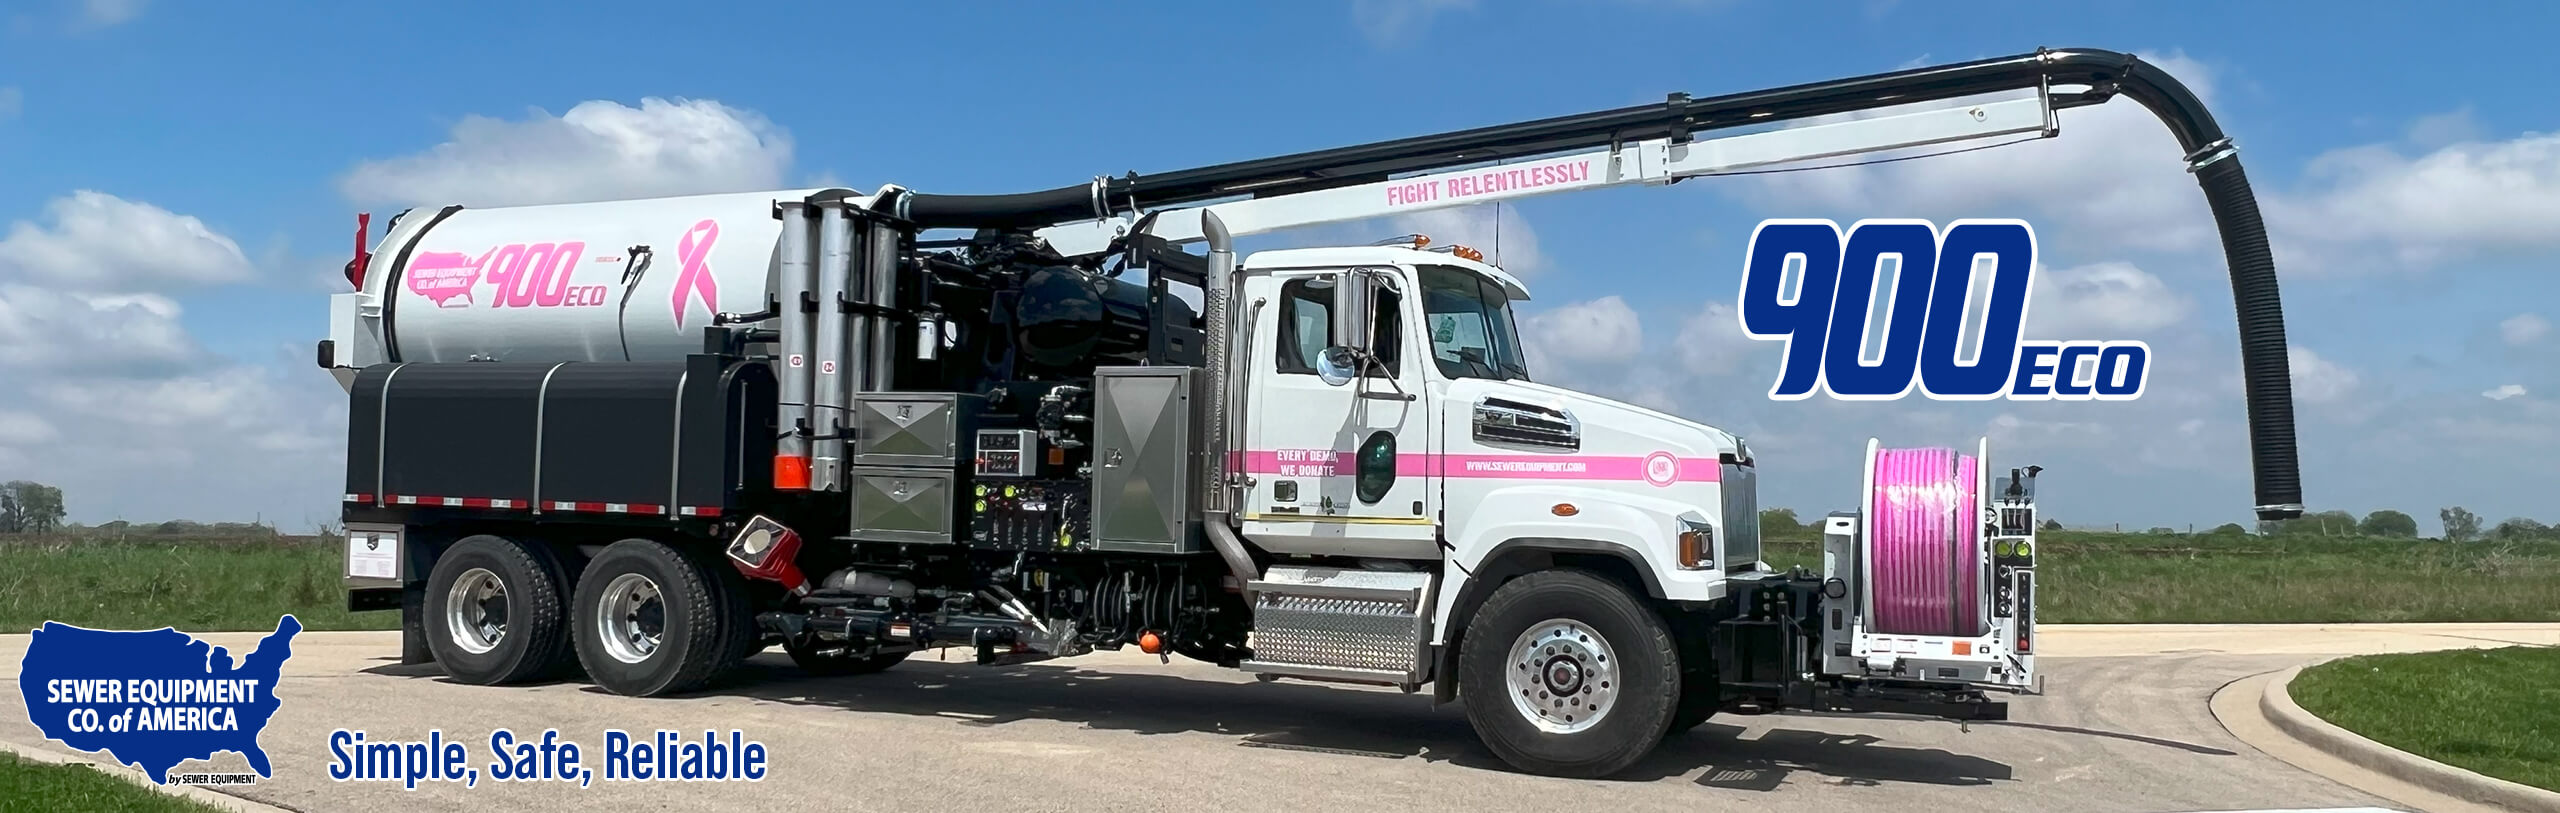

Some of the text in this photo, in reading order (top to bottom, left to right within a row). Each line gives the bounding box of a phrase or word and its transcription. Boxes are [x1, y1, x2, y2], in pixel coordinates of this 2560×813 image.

[1387, 161, 1590, 206] FIGHT RELENTLESSLY
[486, 242, 607, 308] 900 ECO
[1277, 450, 1308, 461] EVERY
[1280, 465, 1335, 477] WE DONATE
